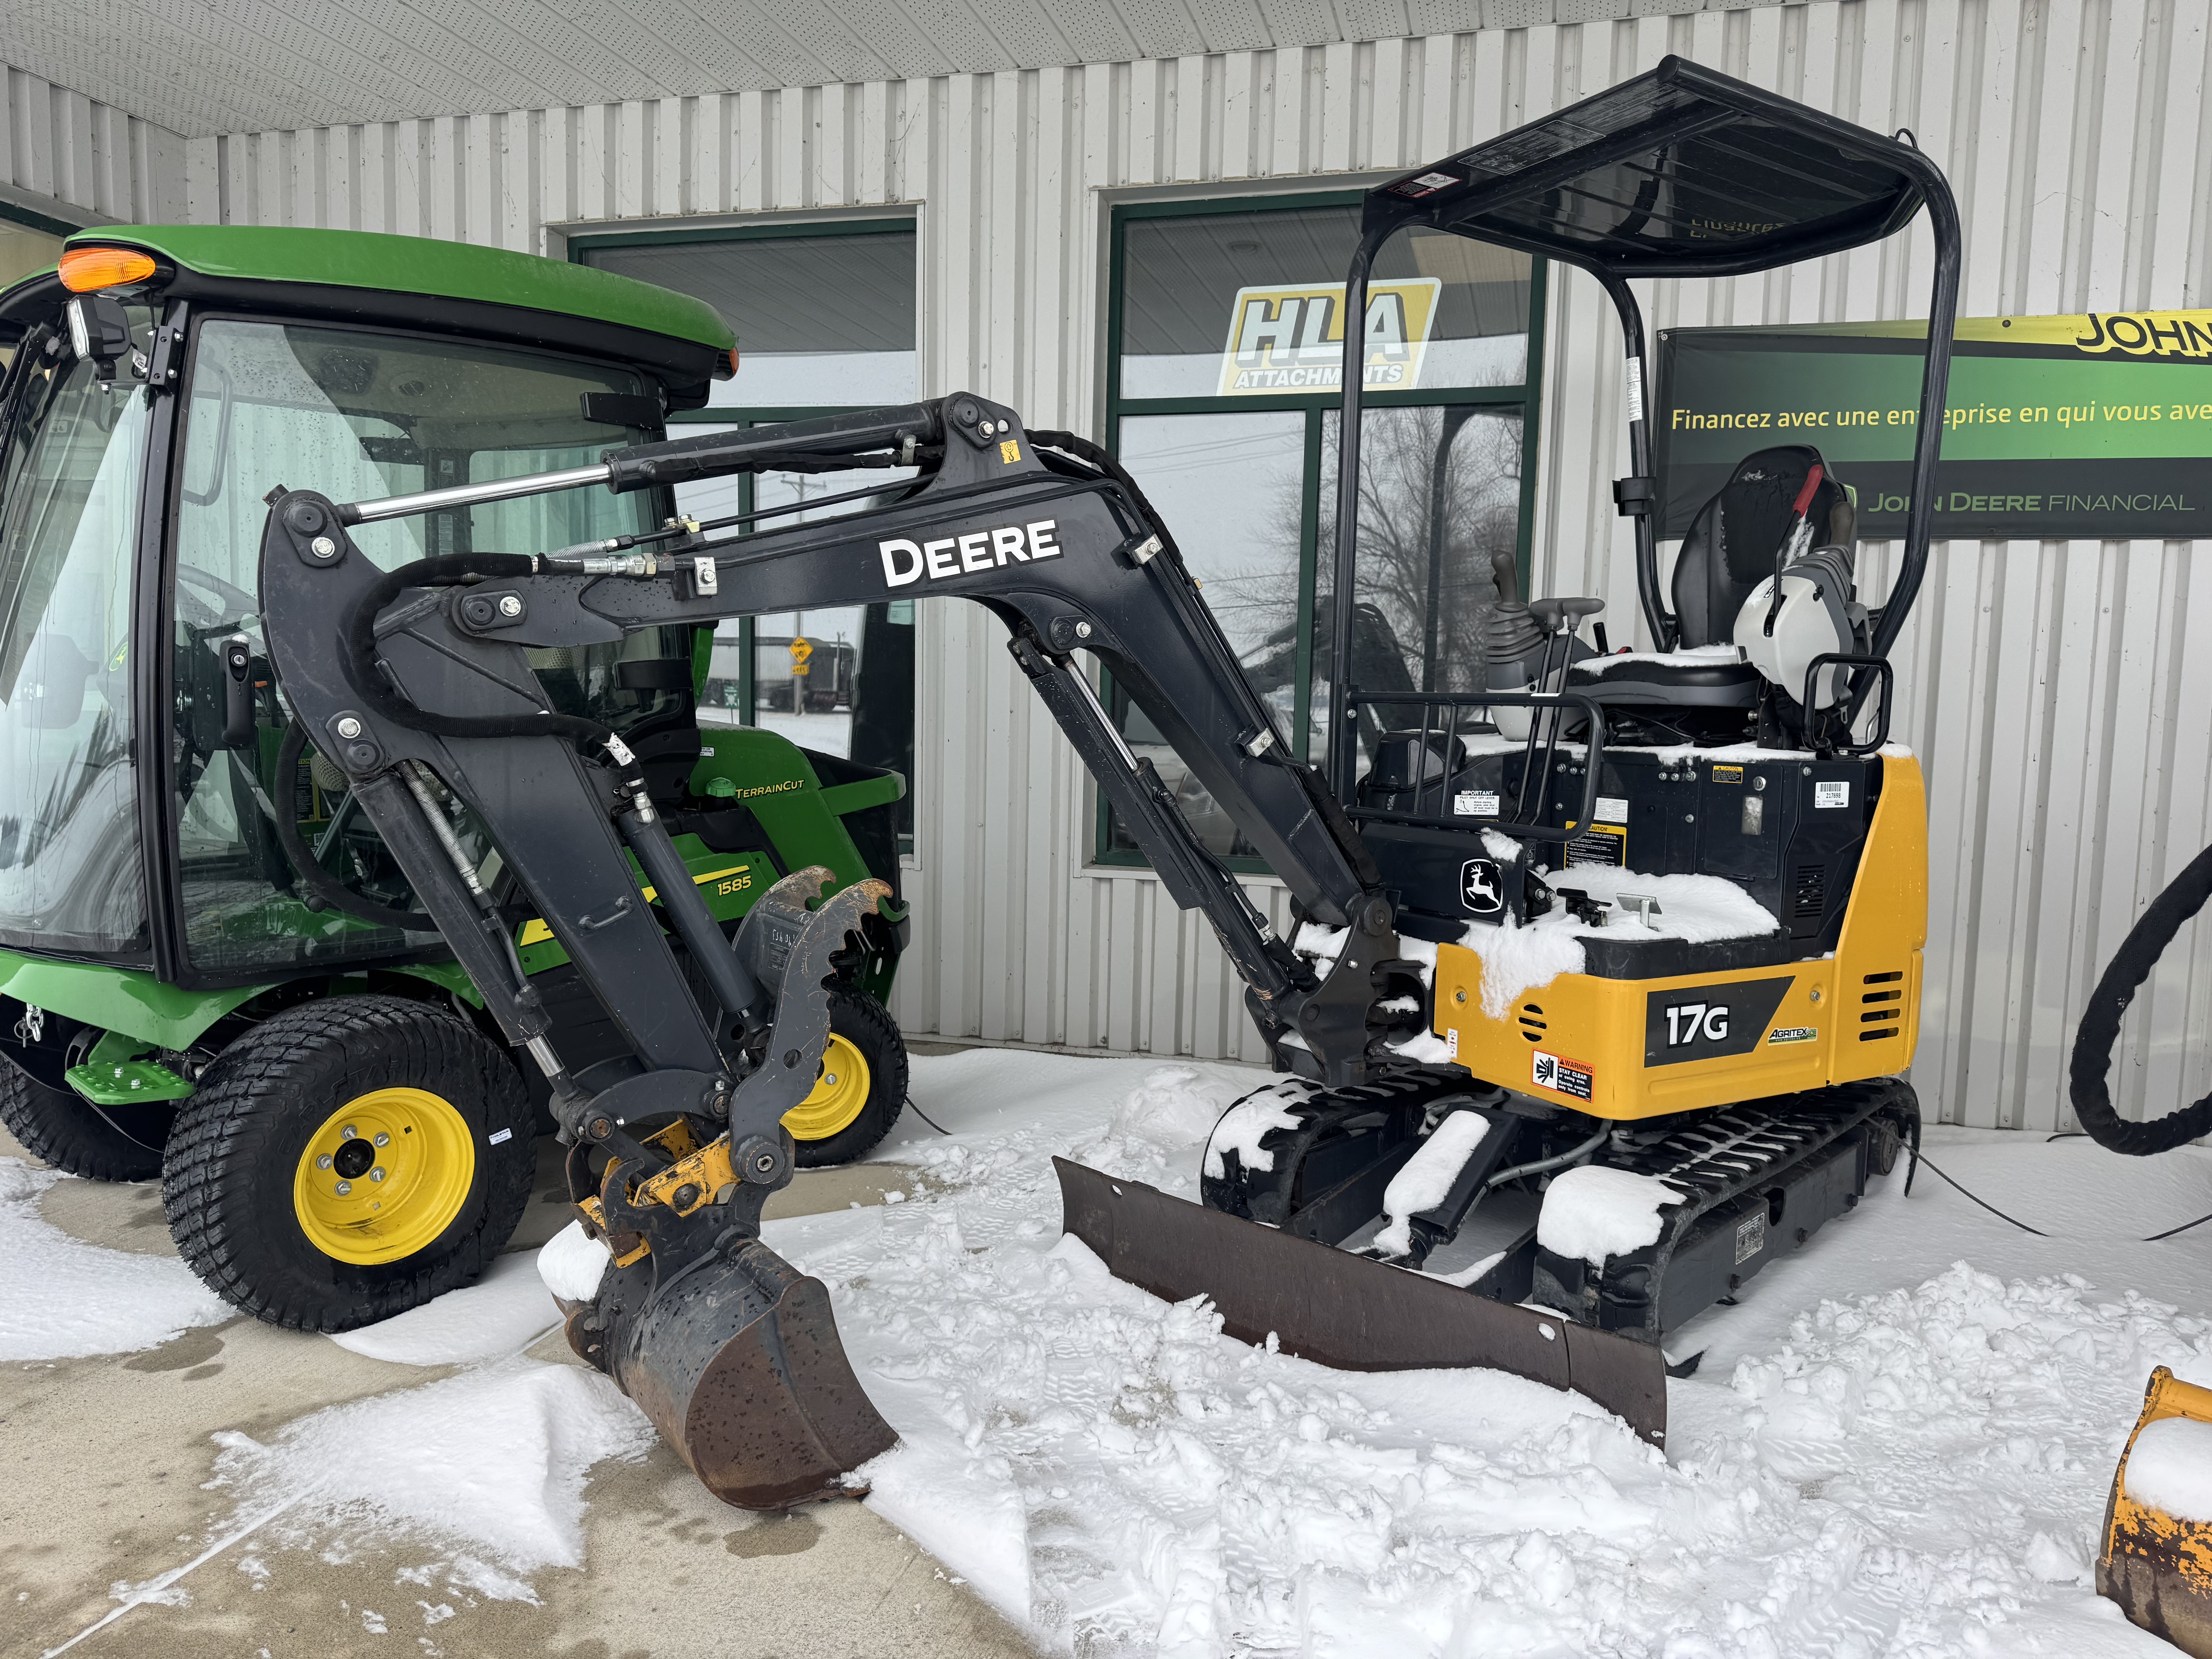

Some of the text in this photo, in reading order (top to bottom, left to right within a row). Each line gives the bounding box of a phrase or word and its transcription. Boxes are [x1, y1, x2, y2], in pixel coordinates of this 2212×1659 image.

[1235, 293, 1410, 367] HLA
[2076, 314, 2212, 351] JOHN
[1235, 364, 1404, 388] ATTACHMNTS
[1673, 409, 1770, 429] Financez
[1778, 411, 1828, 427] avec
[1837, 410, 1879, 426] une
[1887, 403, 2011, 429] eneprise
[2020, 407, 2048, 422] en
[2057, 401, 2095, 428] qui
[2103, 405, 2161, 421] vous
[1950, 492, 2041, 511] DEERE
[2049, 495, 2195, 510] FINANCIAL
[879, 519, 1060, 587] DEERE
[718, 875, 751, 896] 1585
[1667, 1004, 1728, 1045] 17G
[1769, 1028, 1808, 1039] AGRITEX
[1565, 1060, 1593, 1073] WARNING
[1572, 1071, 1587, 1080] CLEAR
